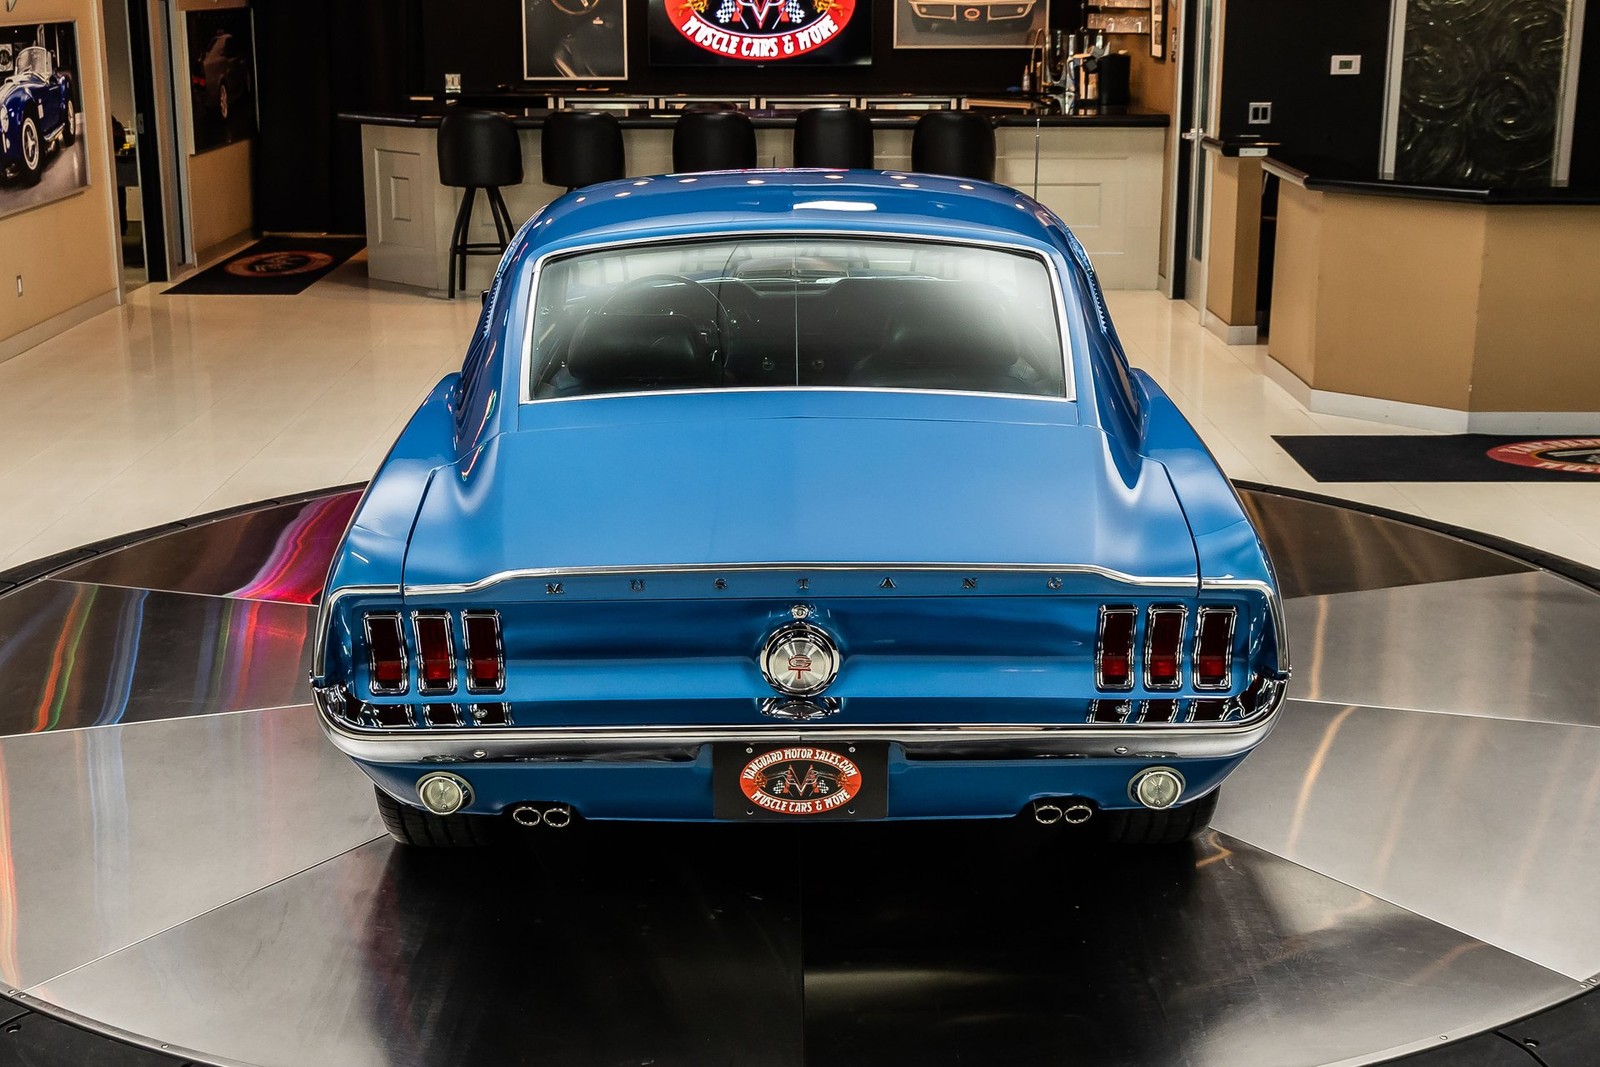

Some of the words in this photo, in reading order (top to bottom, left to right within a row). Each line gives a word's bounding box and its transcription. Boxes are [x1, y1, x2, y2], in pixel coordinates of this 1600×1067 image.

[681, 15, 740, 55] MUSCLE
[741, 37, 778, 57] CARS
[782, 35, 795, 54] &
[796, 14, 839, 51] MORE
[1534, 462, 1600, 474] MUS
[545, 577, 1064, 595] MUSTANG
[743, 751, 783, 780] VANGUARD
[784, 748, 813, 760] MOTOR
[814, 749, 858, 777] SALES.COM
[751, 790, 788, 811] MUSCLE
[789, 801, 812, 813] CARS
[815, 801, 822, 811] &
[823, 789, 850, 808] MORE
